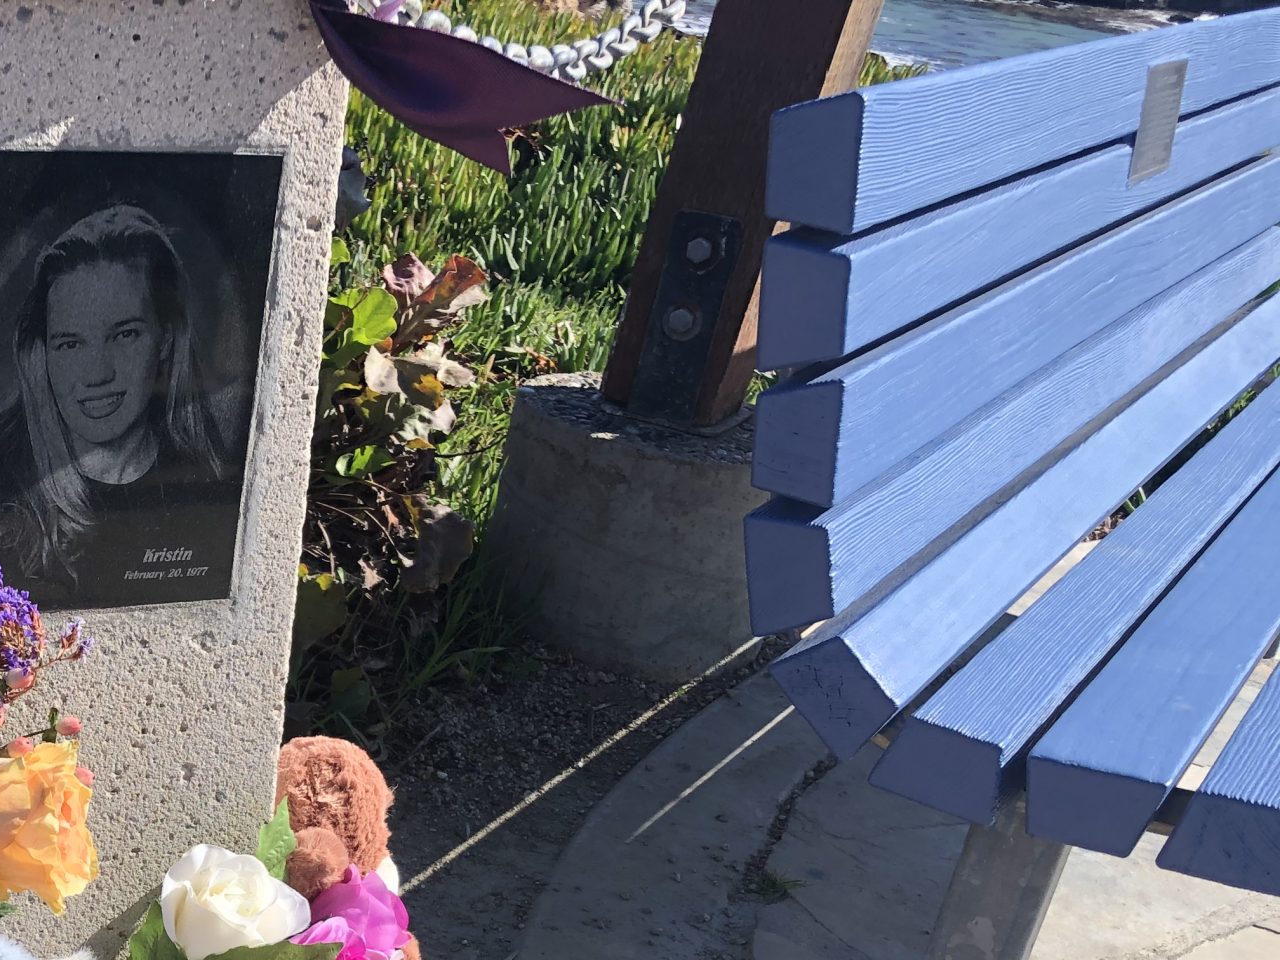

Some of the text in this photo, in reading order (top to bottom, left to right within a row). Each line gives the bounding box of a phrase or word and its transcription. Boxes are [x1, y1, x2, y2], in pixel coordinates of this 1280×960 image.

[142, 547, 193, 563] Kristin
[123, 570, 165, 580] February
[186, 566, 209, 577] 1977
